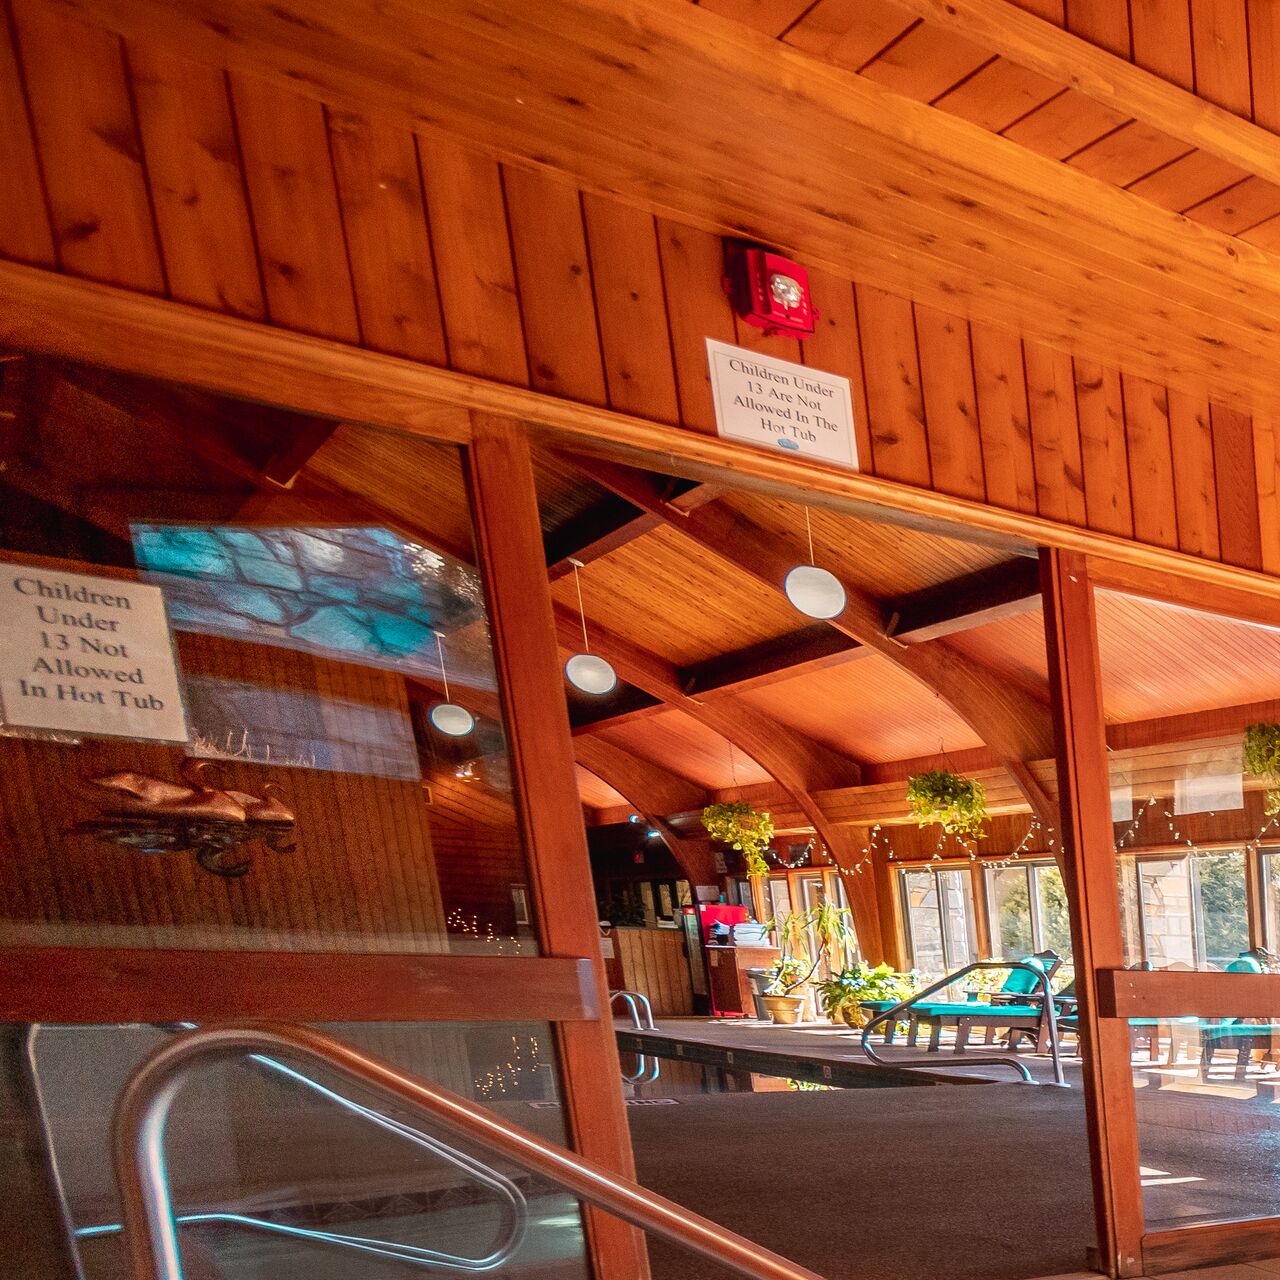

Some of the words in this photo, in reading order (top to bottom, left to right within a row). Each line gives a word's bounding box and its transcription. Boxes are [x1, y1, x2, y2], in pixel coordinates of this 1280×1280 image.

[729, 359, 790, 386] Children
[793, 376, 835, 399] Under
[747, 380, 763, 395] 13
[768, 387, 793, 403] Are
[797, 394, 822, 411] Not
[733, 395, 792, 420] Allowed
[796, 410, 810, 424] In
[813, 414, 838, 432] The
[761, 418, 786, 435] Hot
[789, 425, 817, 443] Tub
[13, 577, 132, 610] Children
[36, 605, 120, 632] Under
[41, 631, 69, 650] 13
[80, 636, 129, 658] Not
[33, 657, 145, 685] Allowed
[19, 679, 48, 698] In
[57, 684, 105, 704] Hot
[112, 690, 165, 711] Tub
